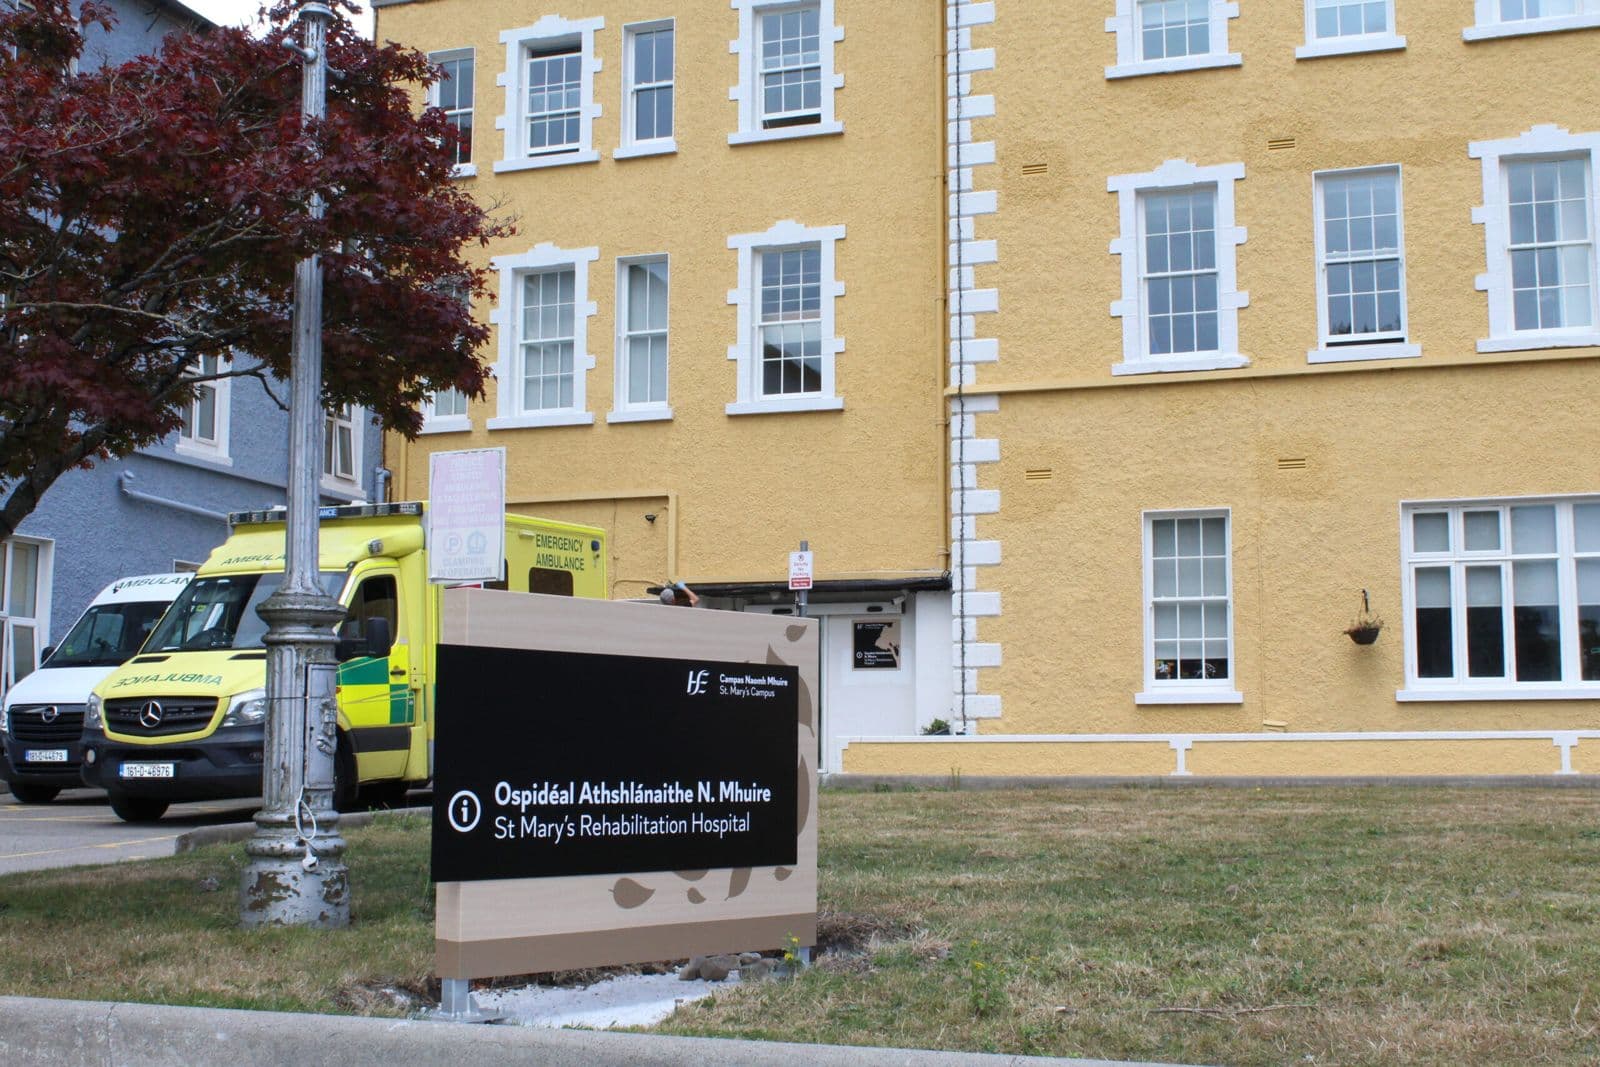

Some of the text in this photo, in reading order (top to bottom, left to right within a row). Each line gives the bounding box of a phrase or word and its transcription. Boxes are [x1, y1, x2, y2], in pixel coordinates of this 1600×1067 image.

[536, 534, 583, 553] EMERGENCY
[221, 554, 288, 566] AMBULA
[536, 553, 584, 571] AMBULANCE
[116, 577, 190, 589] AMBULAN
[767, 676, 788, 687] Mhuire
[750, 687, 775, 698] Campus
[494, 781, 772, 813] Ospidéal Athshlánaithe N. Mhuire
[494, 811, 750, 844] St Mary's Rehabilitation Hospital
